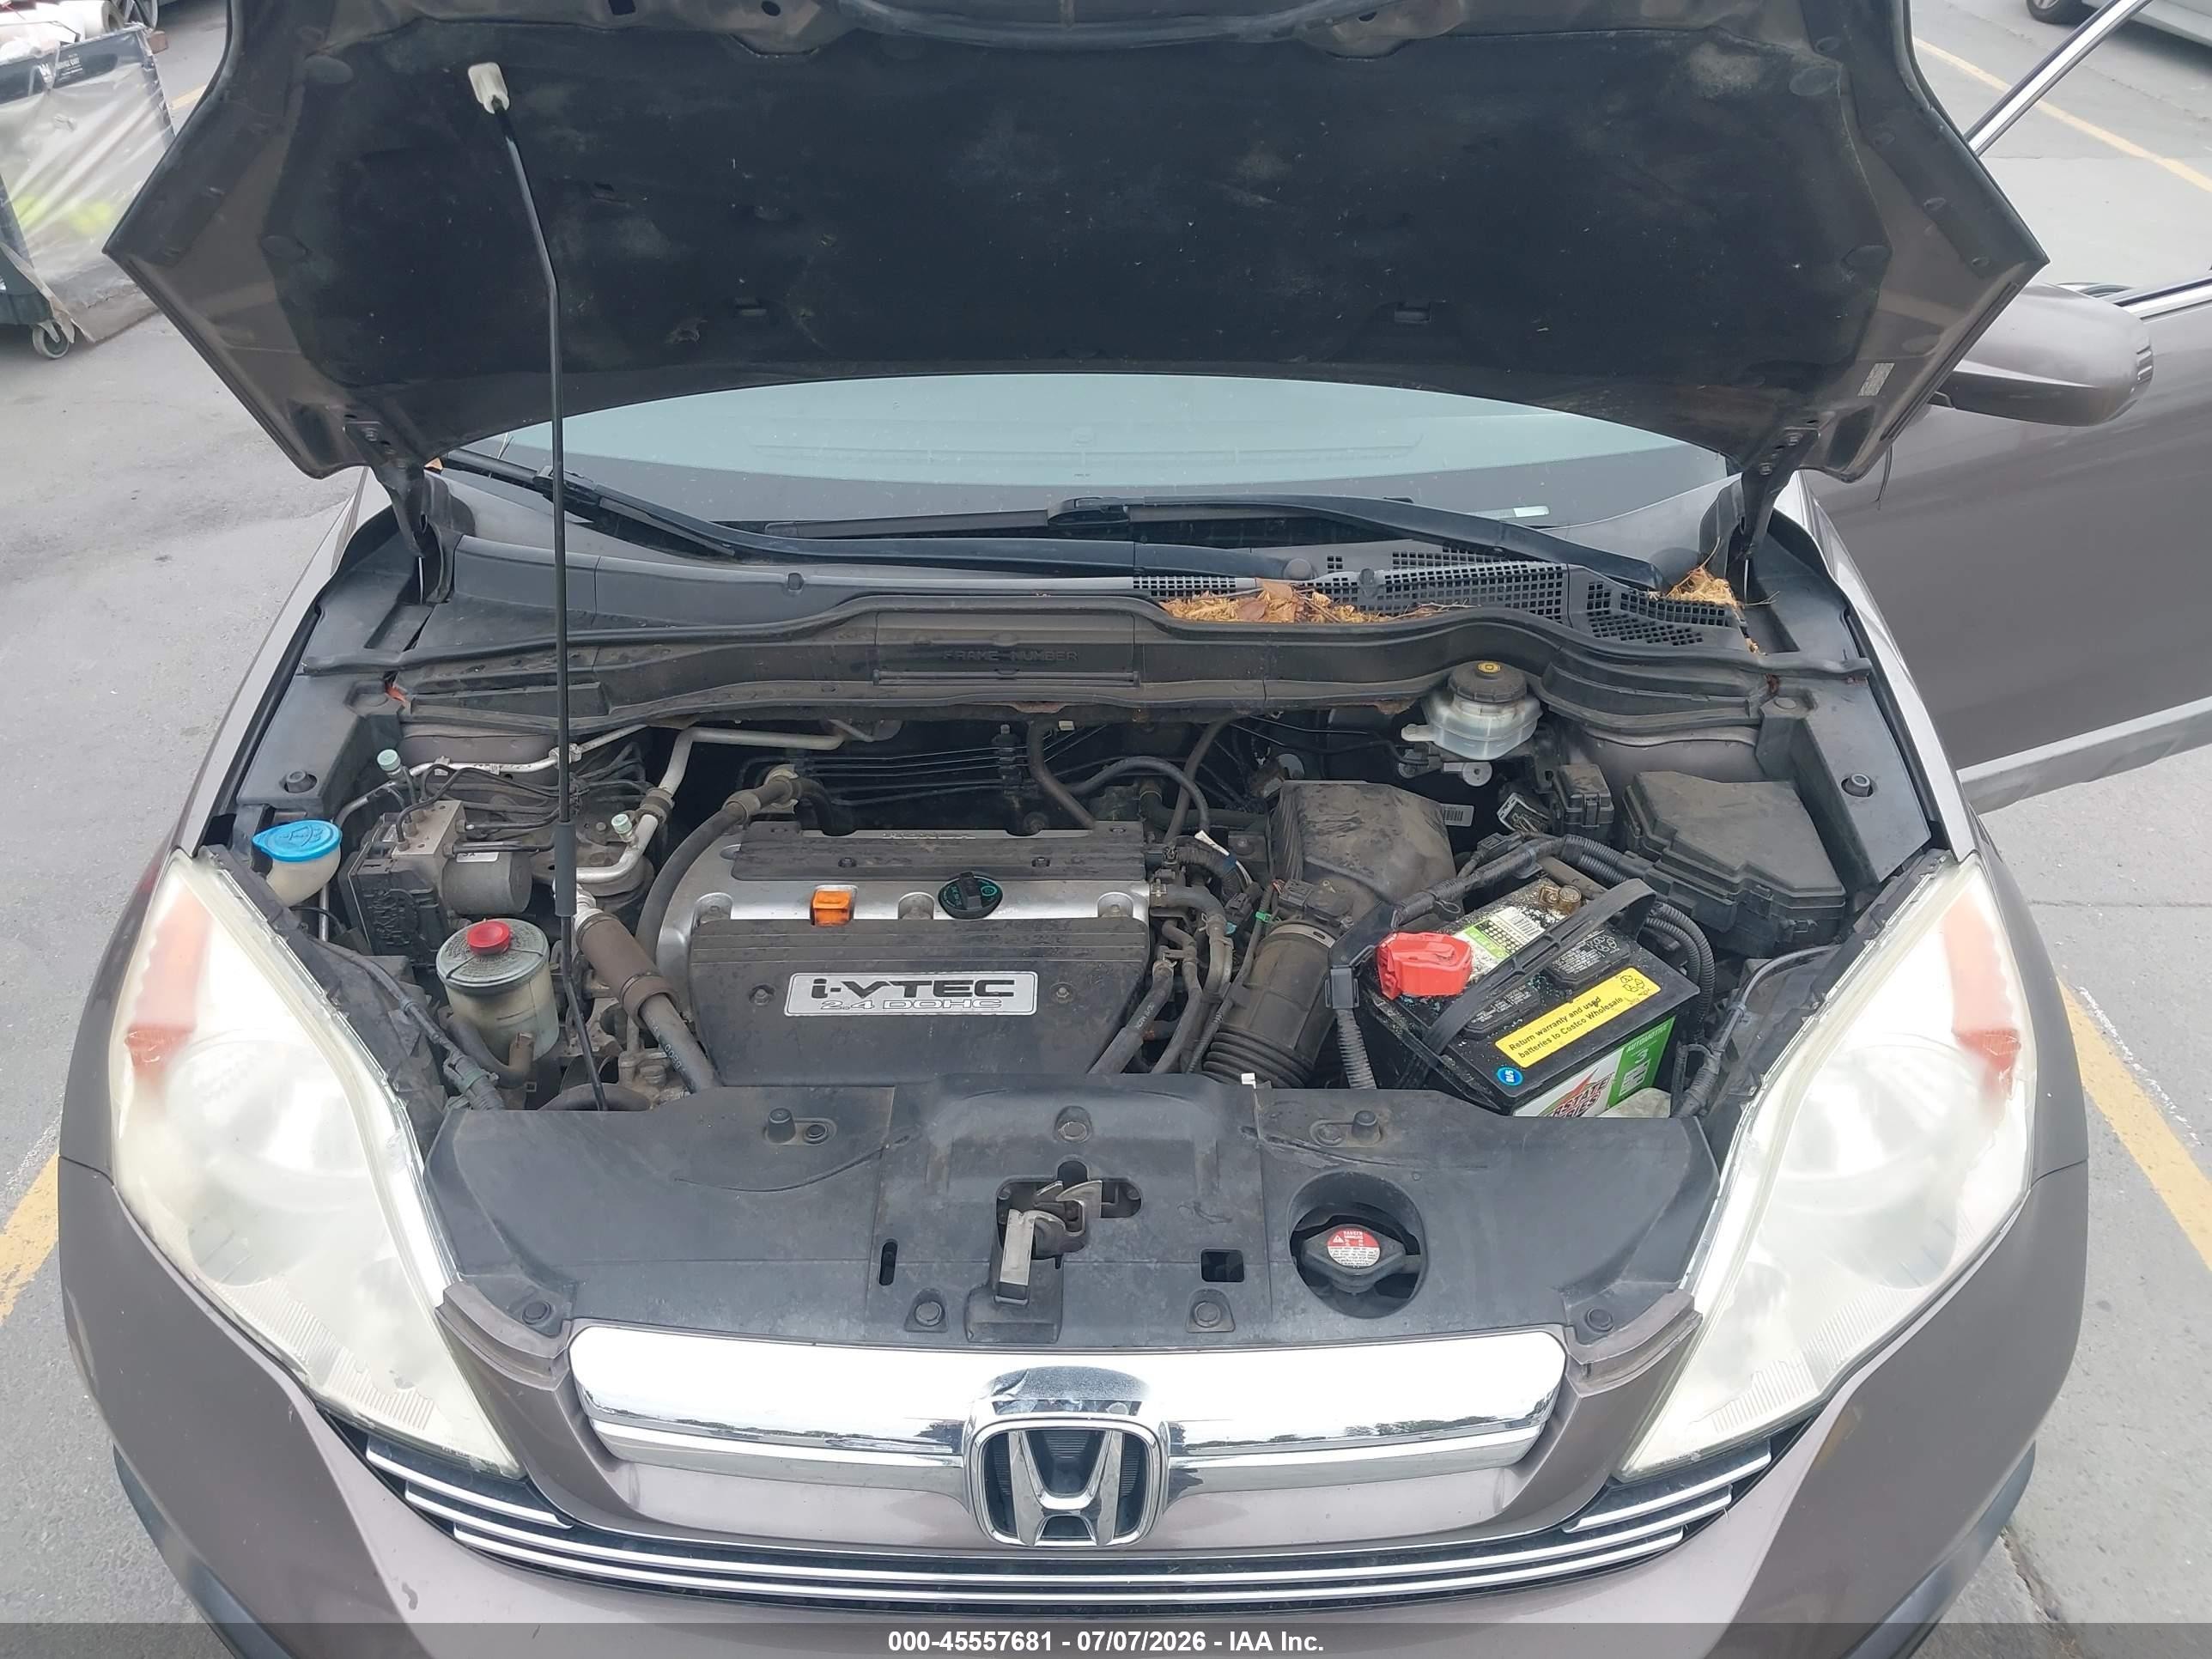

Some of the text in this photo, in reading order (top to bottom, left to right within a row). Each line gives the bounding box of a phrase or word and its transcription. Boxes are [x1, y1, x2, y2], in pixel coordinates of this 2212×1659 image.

[944, 650, 1079, 660] FRAME NUMBER
[811, 978, 1015, 999] i-VTEC
[821, 999, 1003, 1010] 2.4 DOHC
[1509, 996, 1601, 1051] Return warranty and used
[1518, 997, 1624, 1059] batteries to Costco Wholesale
[1552, 1075, 1611, 1116] RSTATE
